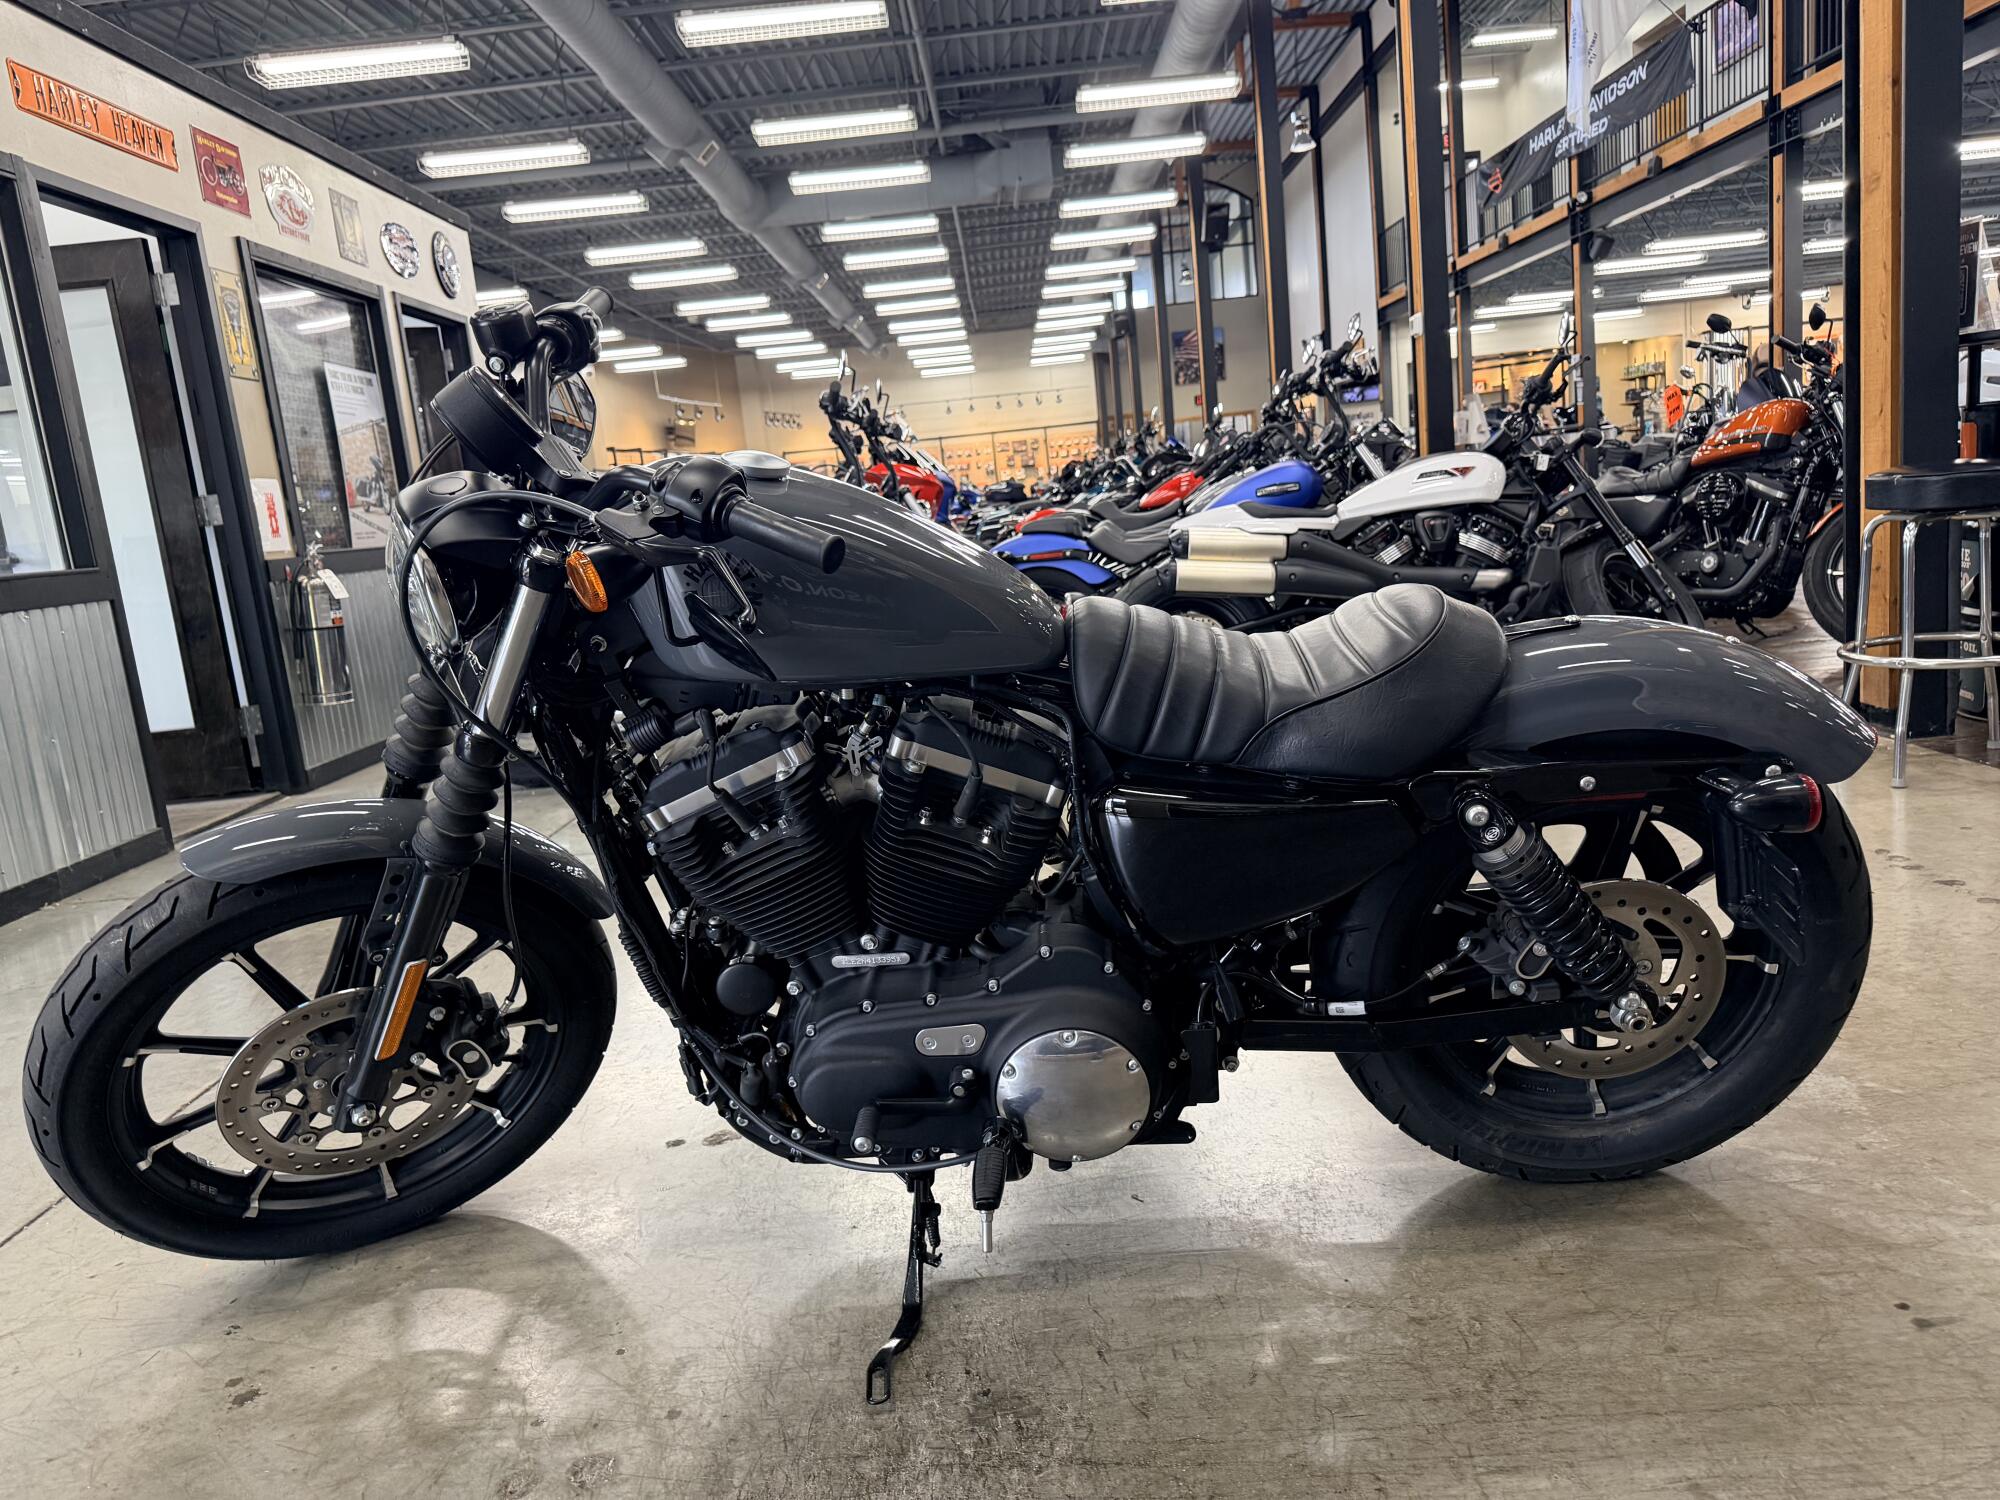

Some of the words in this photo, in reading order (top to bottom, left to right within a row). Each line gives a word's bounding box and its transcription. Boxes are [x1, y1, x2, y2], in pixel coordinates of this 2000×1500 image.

[32, 72, 101, 134] HARLEY
[109, 106, 167, 162] HEAVEN
[1529, 61, 1649, 155] HARLEAVIDSON
